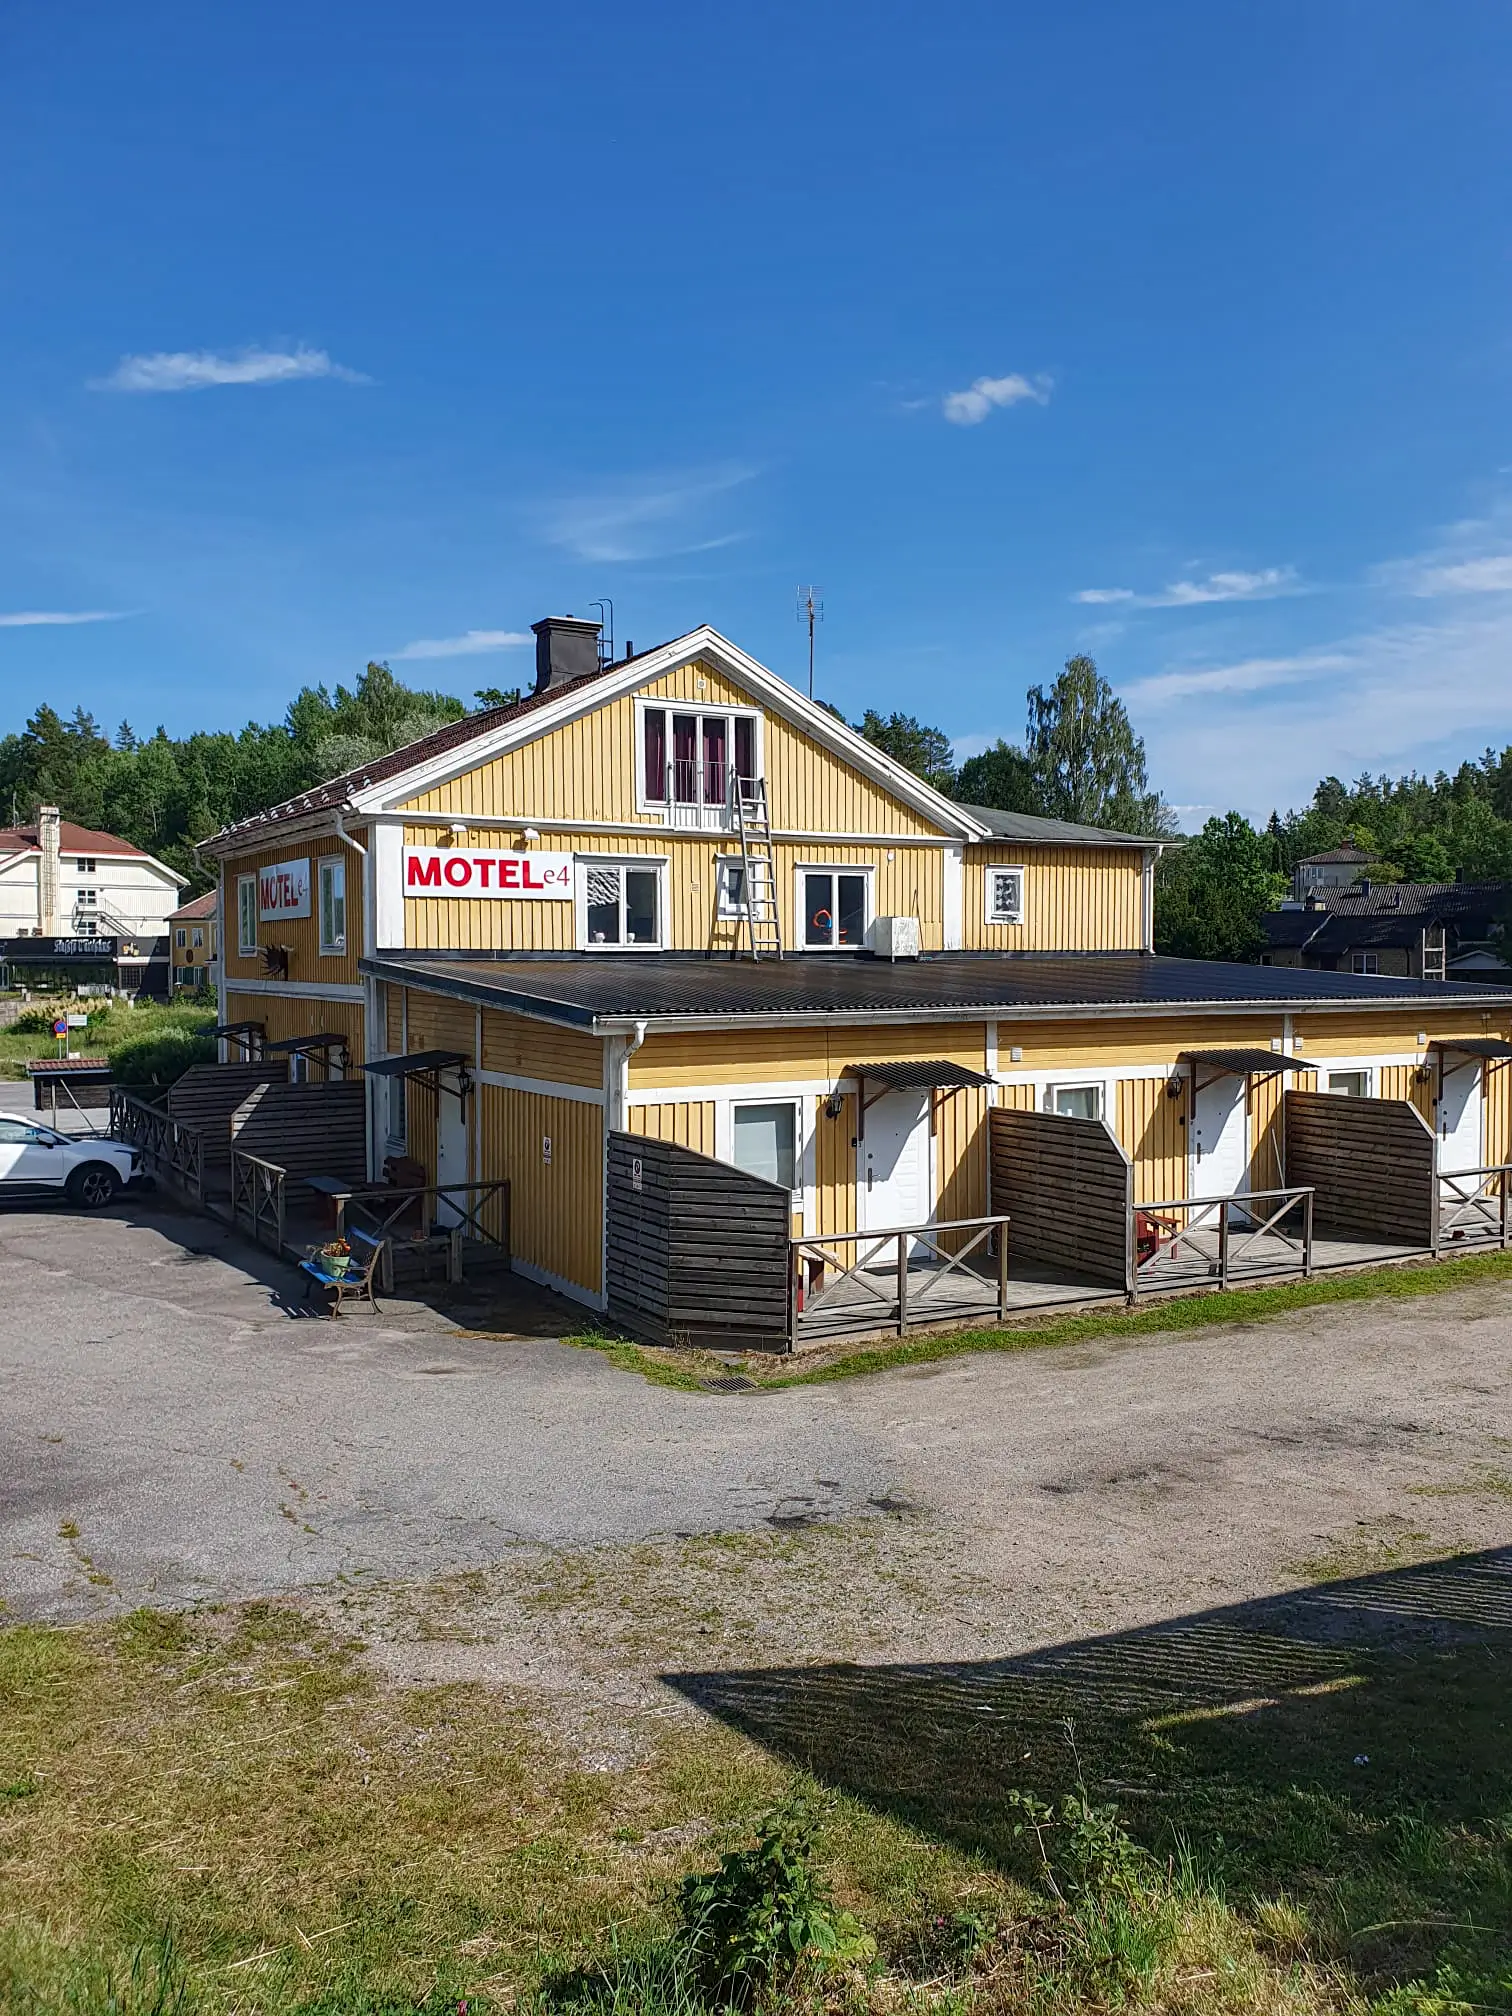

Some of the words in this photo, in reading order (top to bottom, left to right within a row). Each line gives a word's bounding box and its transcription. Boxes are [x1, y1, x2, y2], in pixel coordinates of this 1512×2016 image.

[407, 856, 544, 889] MOTEL
[543, 865, 571, 887] e4
[261, 872, 299, 910] MOTEL
